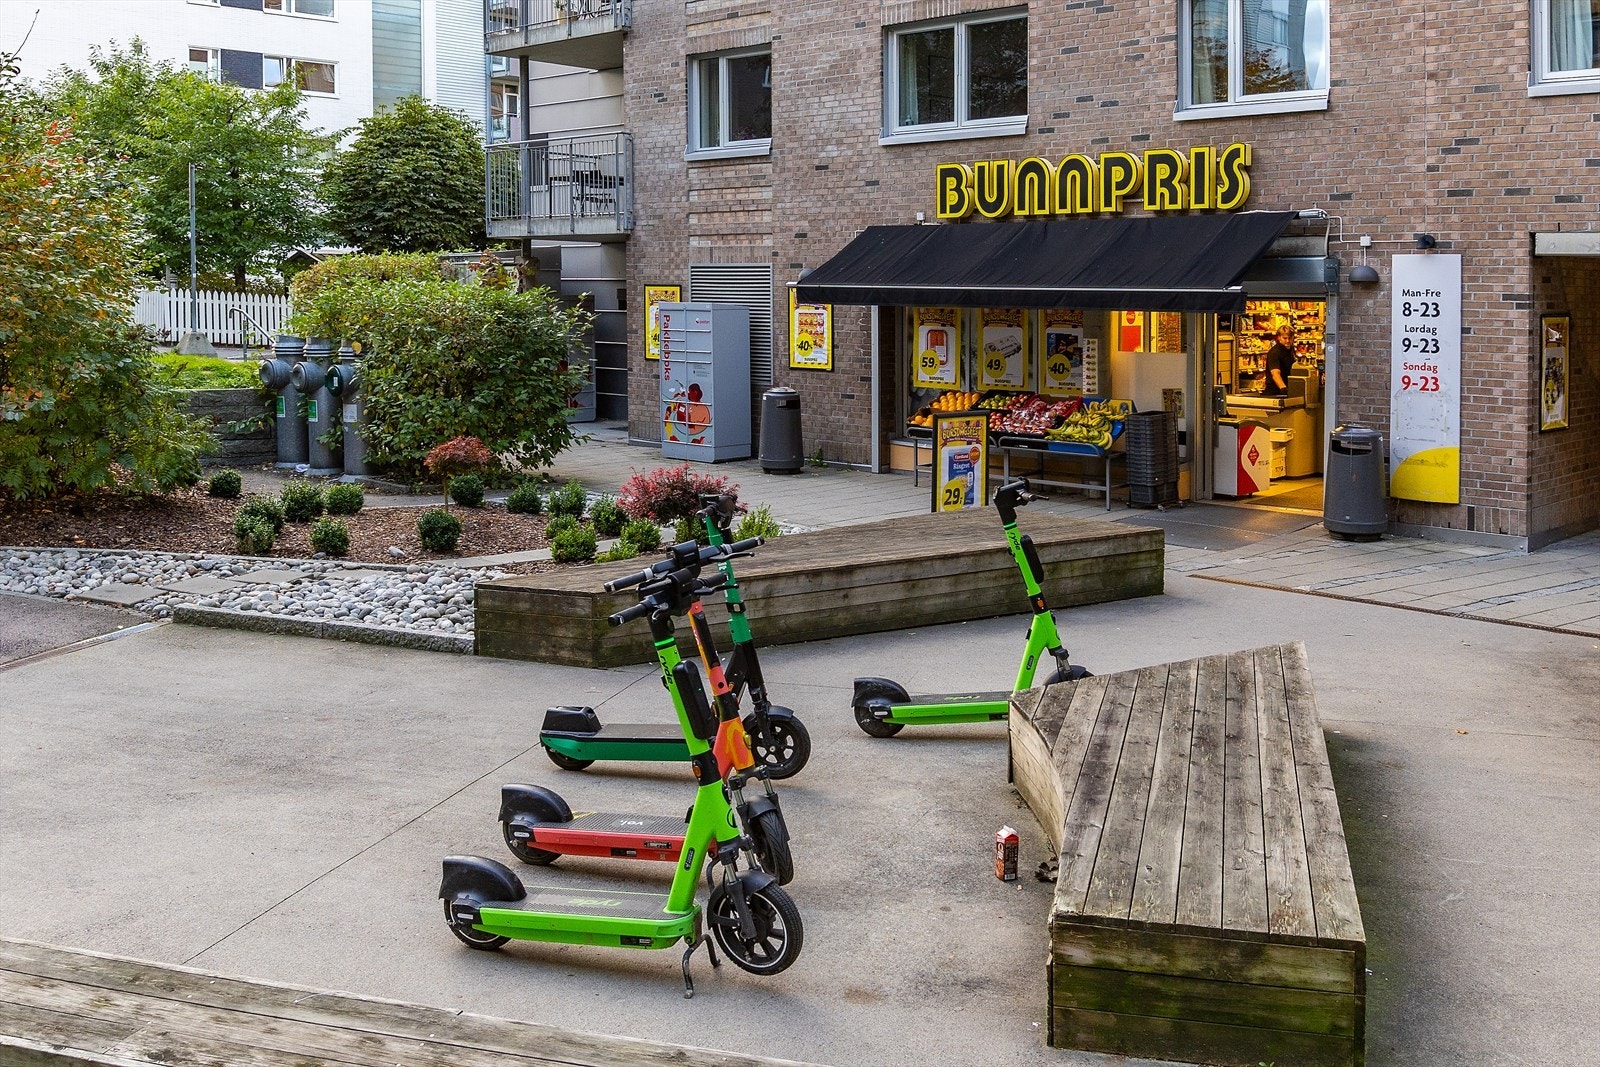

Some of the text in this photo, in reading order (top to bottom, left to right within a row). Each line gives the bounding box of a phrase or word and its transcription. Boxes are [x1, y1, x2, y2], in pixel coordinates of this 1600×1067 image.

[936, 143, 1251, 218] BUNNPRIS
[1402, 288, 1441, 298] Man-Fre
[1402, 301, 1440, 318] 8-23
[1404, 324, 1438, 336] Lørdag
[663, 314, 671, 381] Pakkeboks
[1402, 337, 1440, 353] 9-23
[1403, 362, 1438, 374] Søndag
[1401, 375, 1440, 392] 9-23
[660, 655, 673, 685] ryde
